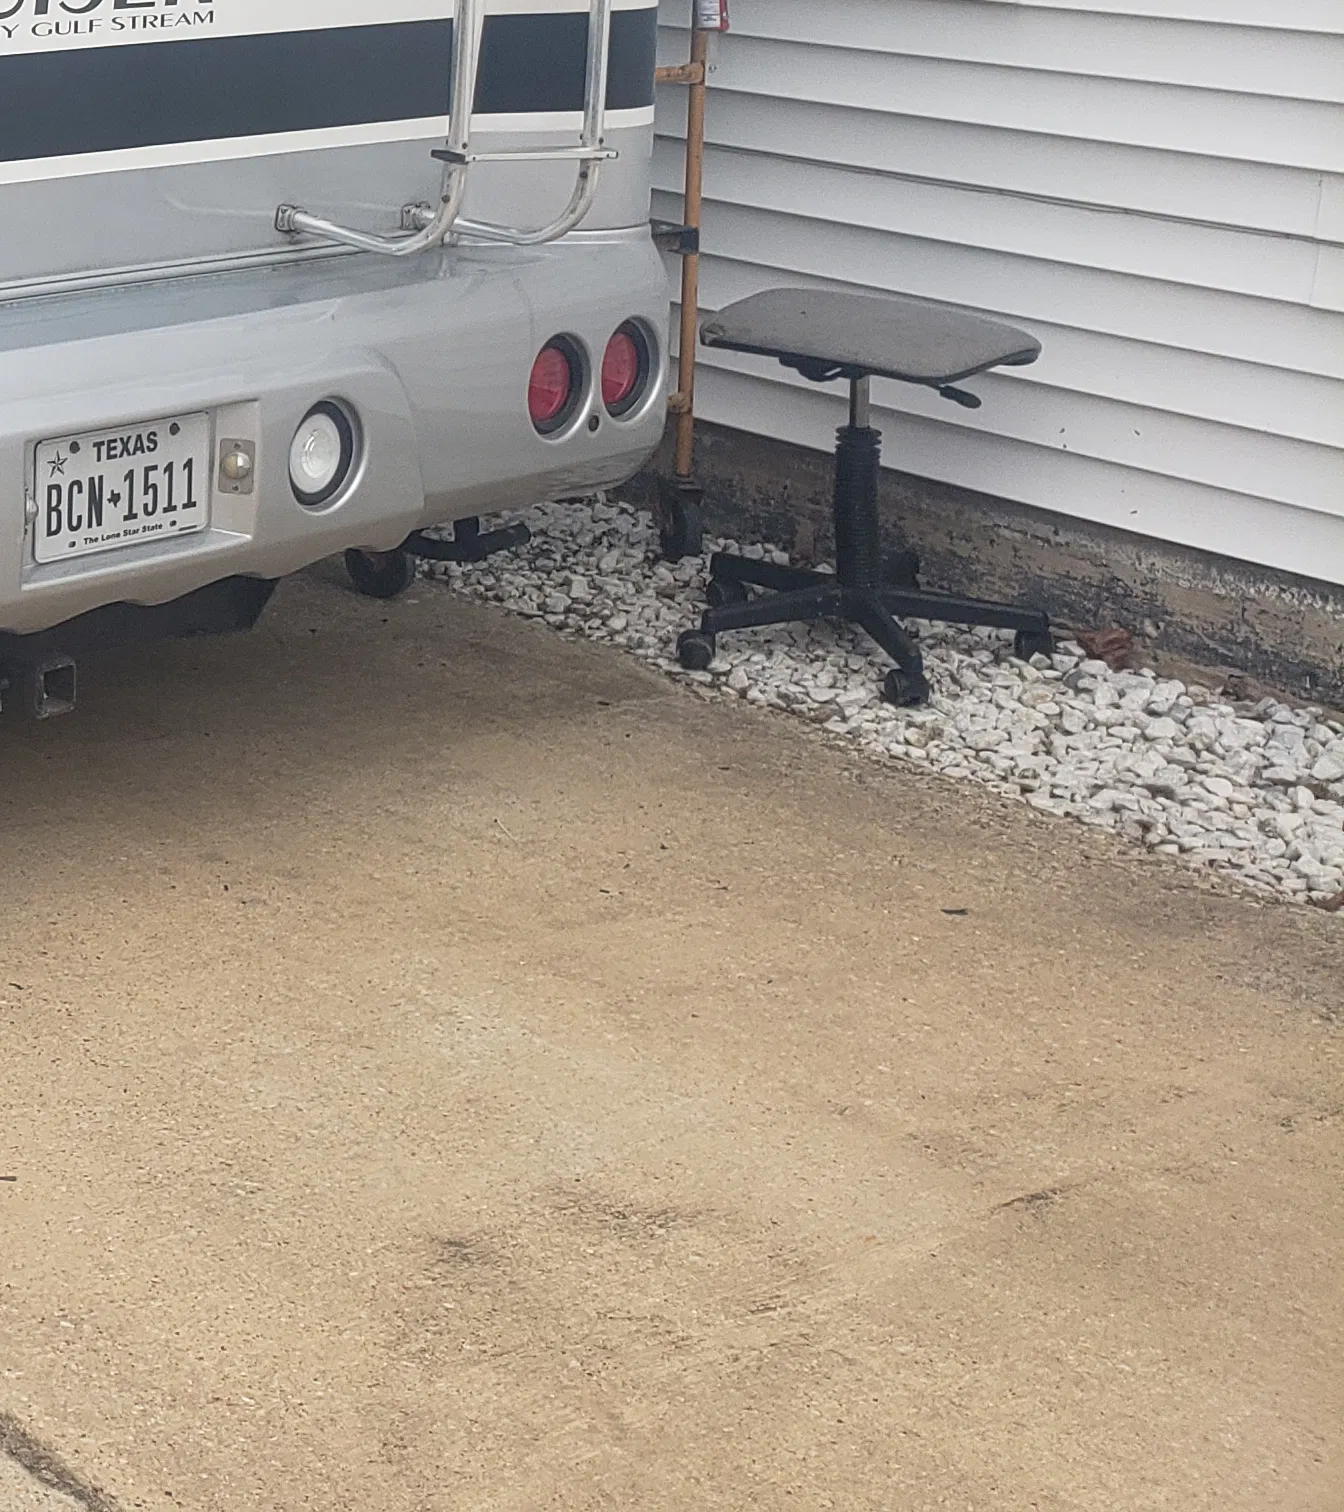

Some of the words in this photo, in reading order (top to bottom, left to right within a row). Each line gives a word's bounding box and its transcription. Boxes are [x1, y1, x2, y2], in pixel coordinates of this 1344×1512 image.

[30, 17, 104, 37] GULF
[110, 9, 216, 32] STREAM
[92, 431, 158, 463] TEXAS
[83, 536, 99, 546] The
[101, 531, 121, 542] Lone
[123, 527, 140, 537] Star
[141, 522, 163, 534] State
